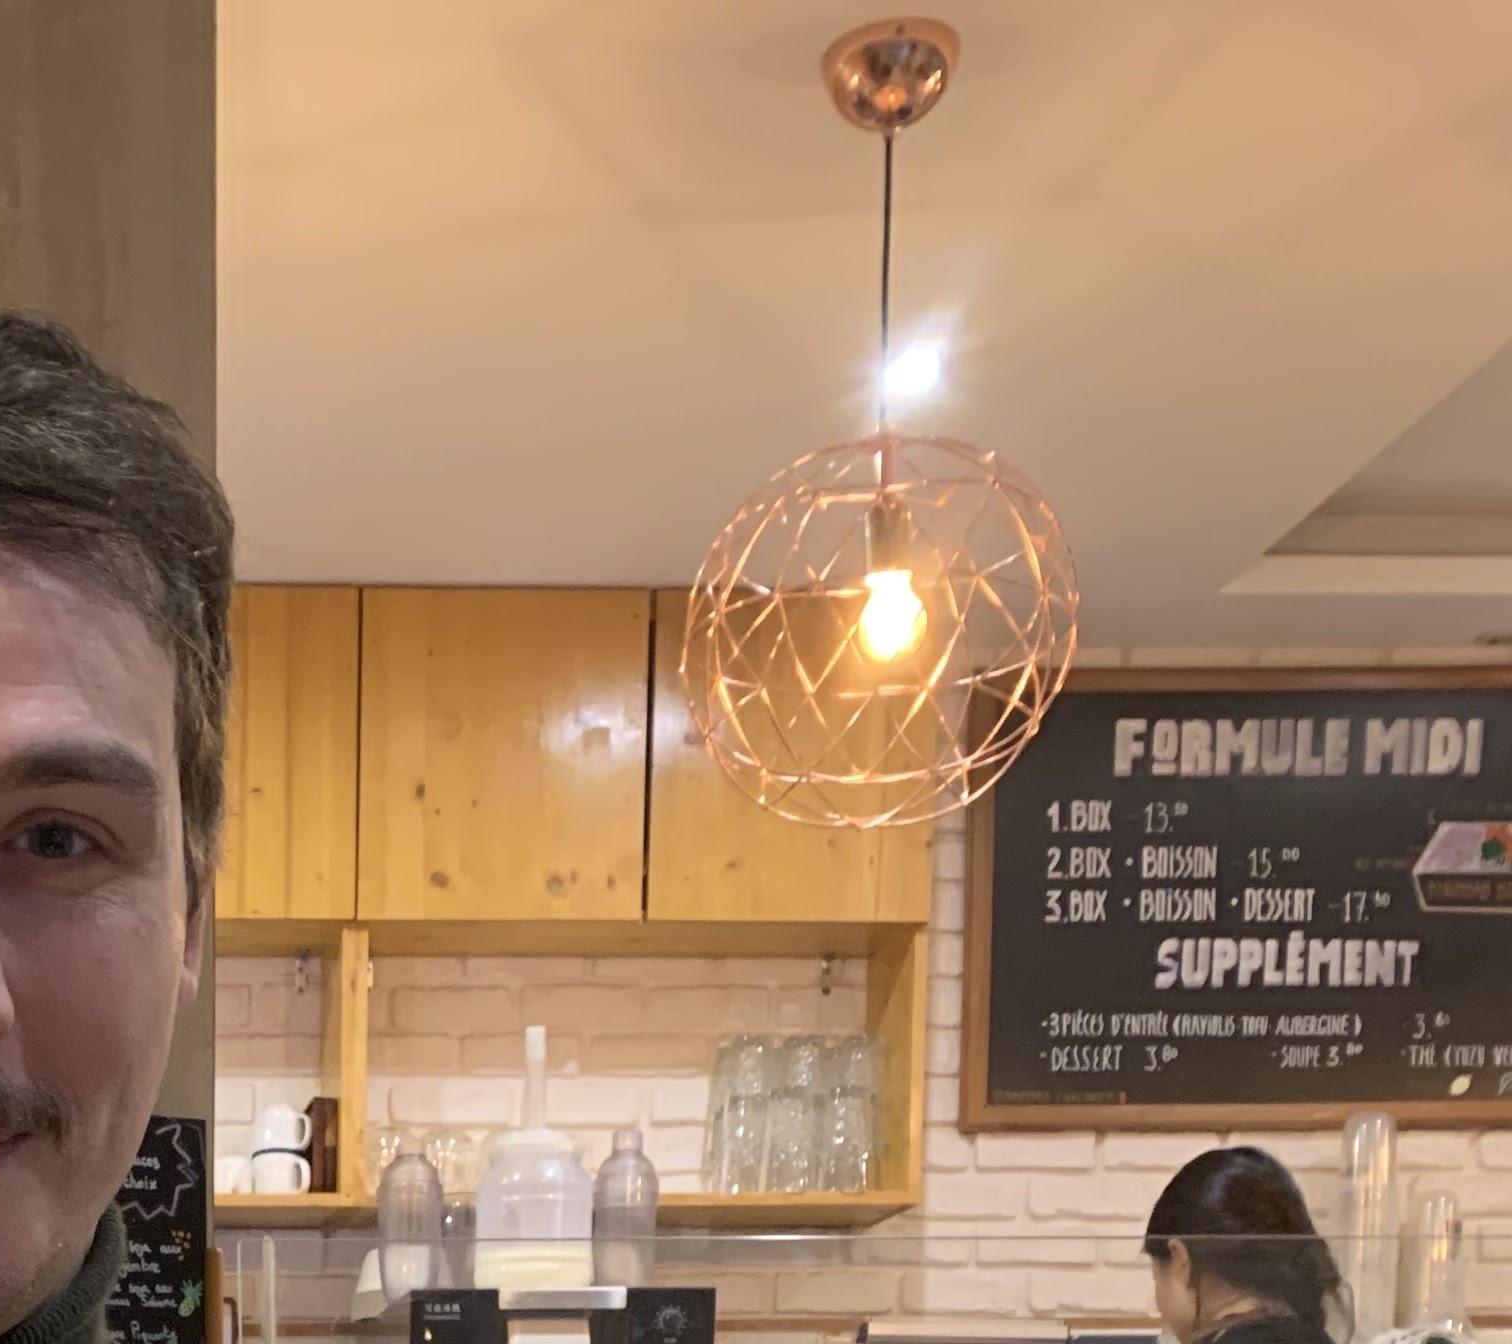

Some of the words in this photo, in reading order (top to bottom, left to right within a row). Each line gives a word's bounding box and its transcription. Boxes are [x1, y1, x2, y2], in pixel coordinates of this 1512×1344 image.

[1113, 718, 1350, 777] FORMULE
[1364, 718, 1485, 777] MIDI
[1142, 846, 1218, 879] BOISSON
[1140, 888, 1216, 922] BOISSON
[1244, 888, 1315, 922] DESSERT
[1155, 930, 1420, 989] SUPPLÉMENT
[1051, 1045, 1123, 1072] DESSERT
[1280, 1045, 1320, 1068] SOUPE
